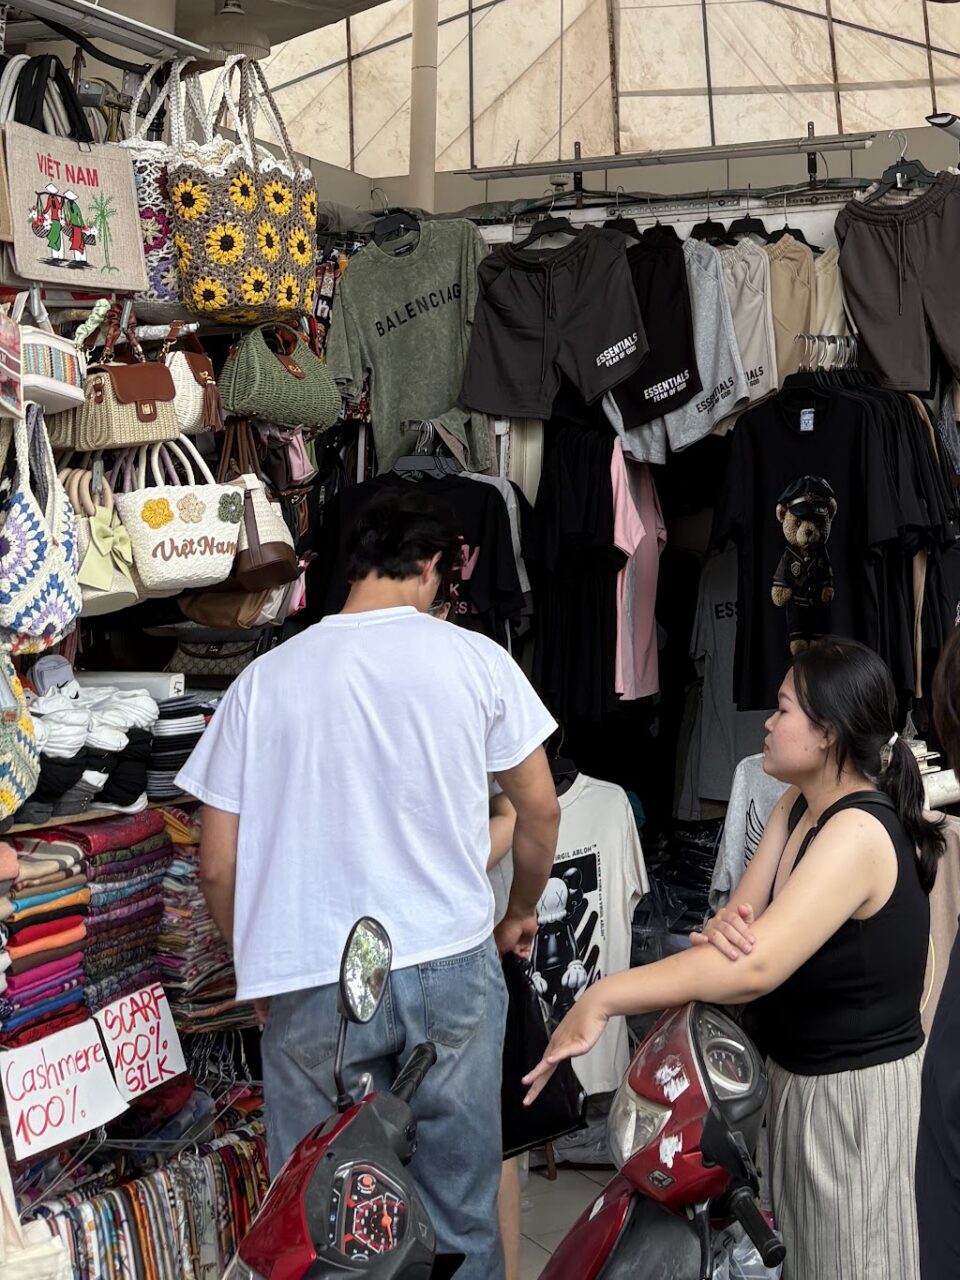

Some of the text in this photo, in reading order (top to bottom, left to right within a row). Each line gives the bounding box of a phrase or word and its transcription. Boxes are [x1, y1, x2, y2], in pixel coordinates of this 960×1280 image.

[36, 152, 99, 188] VIỆT NAM
[375, 283, 461, 337] BALENCIAG
[596, 332, 638, 366] ESSENTIALS
[643, 369, 690, 400] ESSENTIALS
[197, 535, 237, 556] Nam
[104, 985, 167, 1040] SCARF
[115, 1021, 168, 1071] 100%
[6, 1043, 105, 1102] Cashmere
[125, 1055, 176, 1093] SILK
[16, 1085, 86, 1146] 100%
